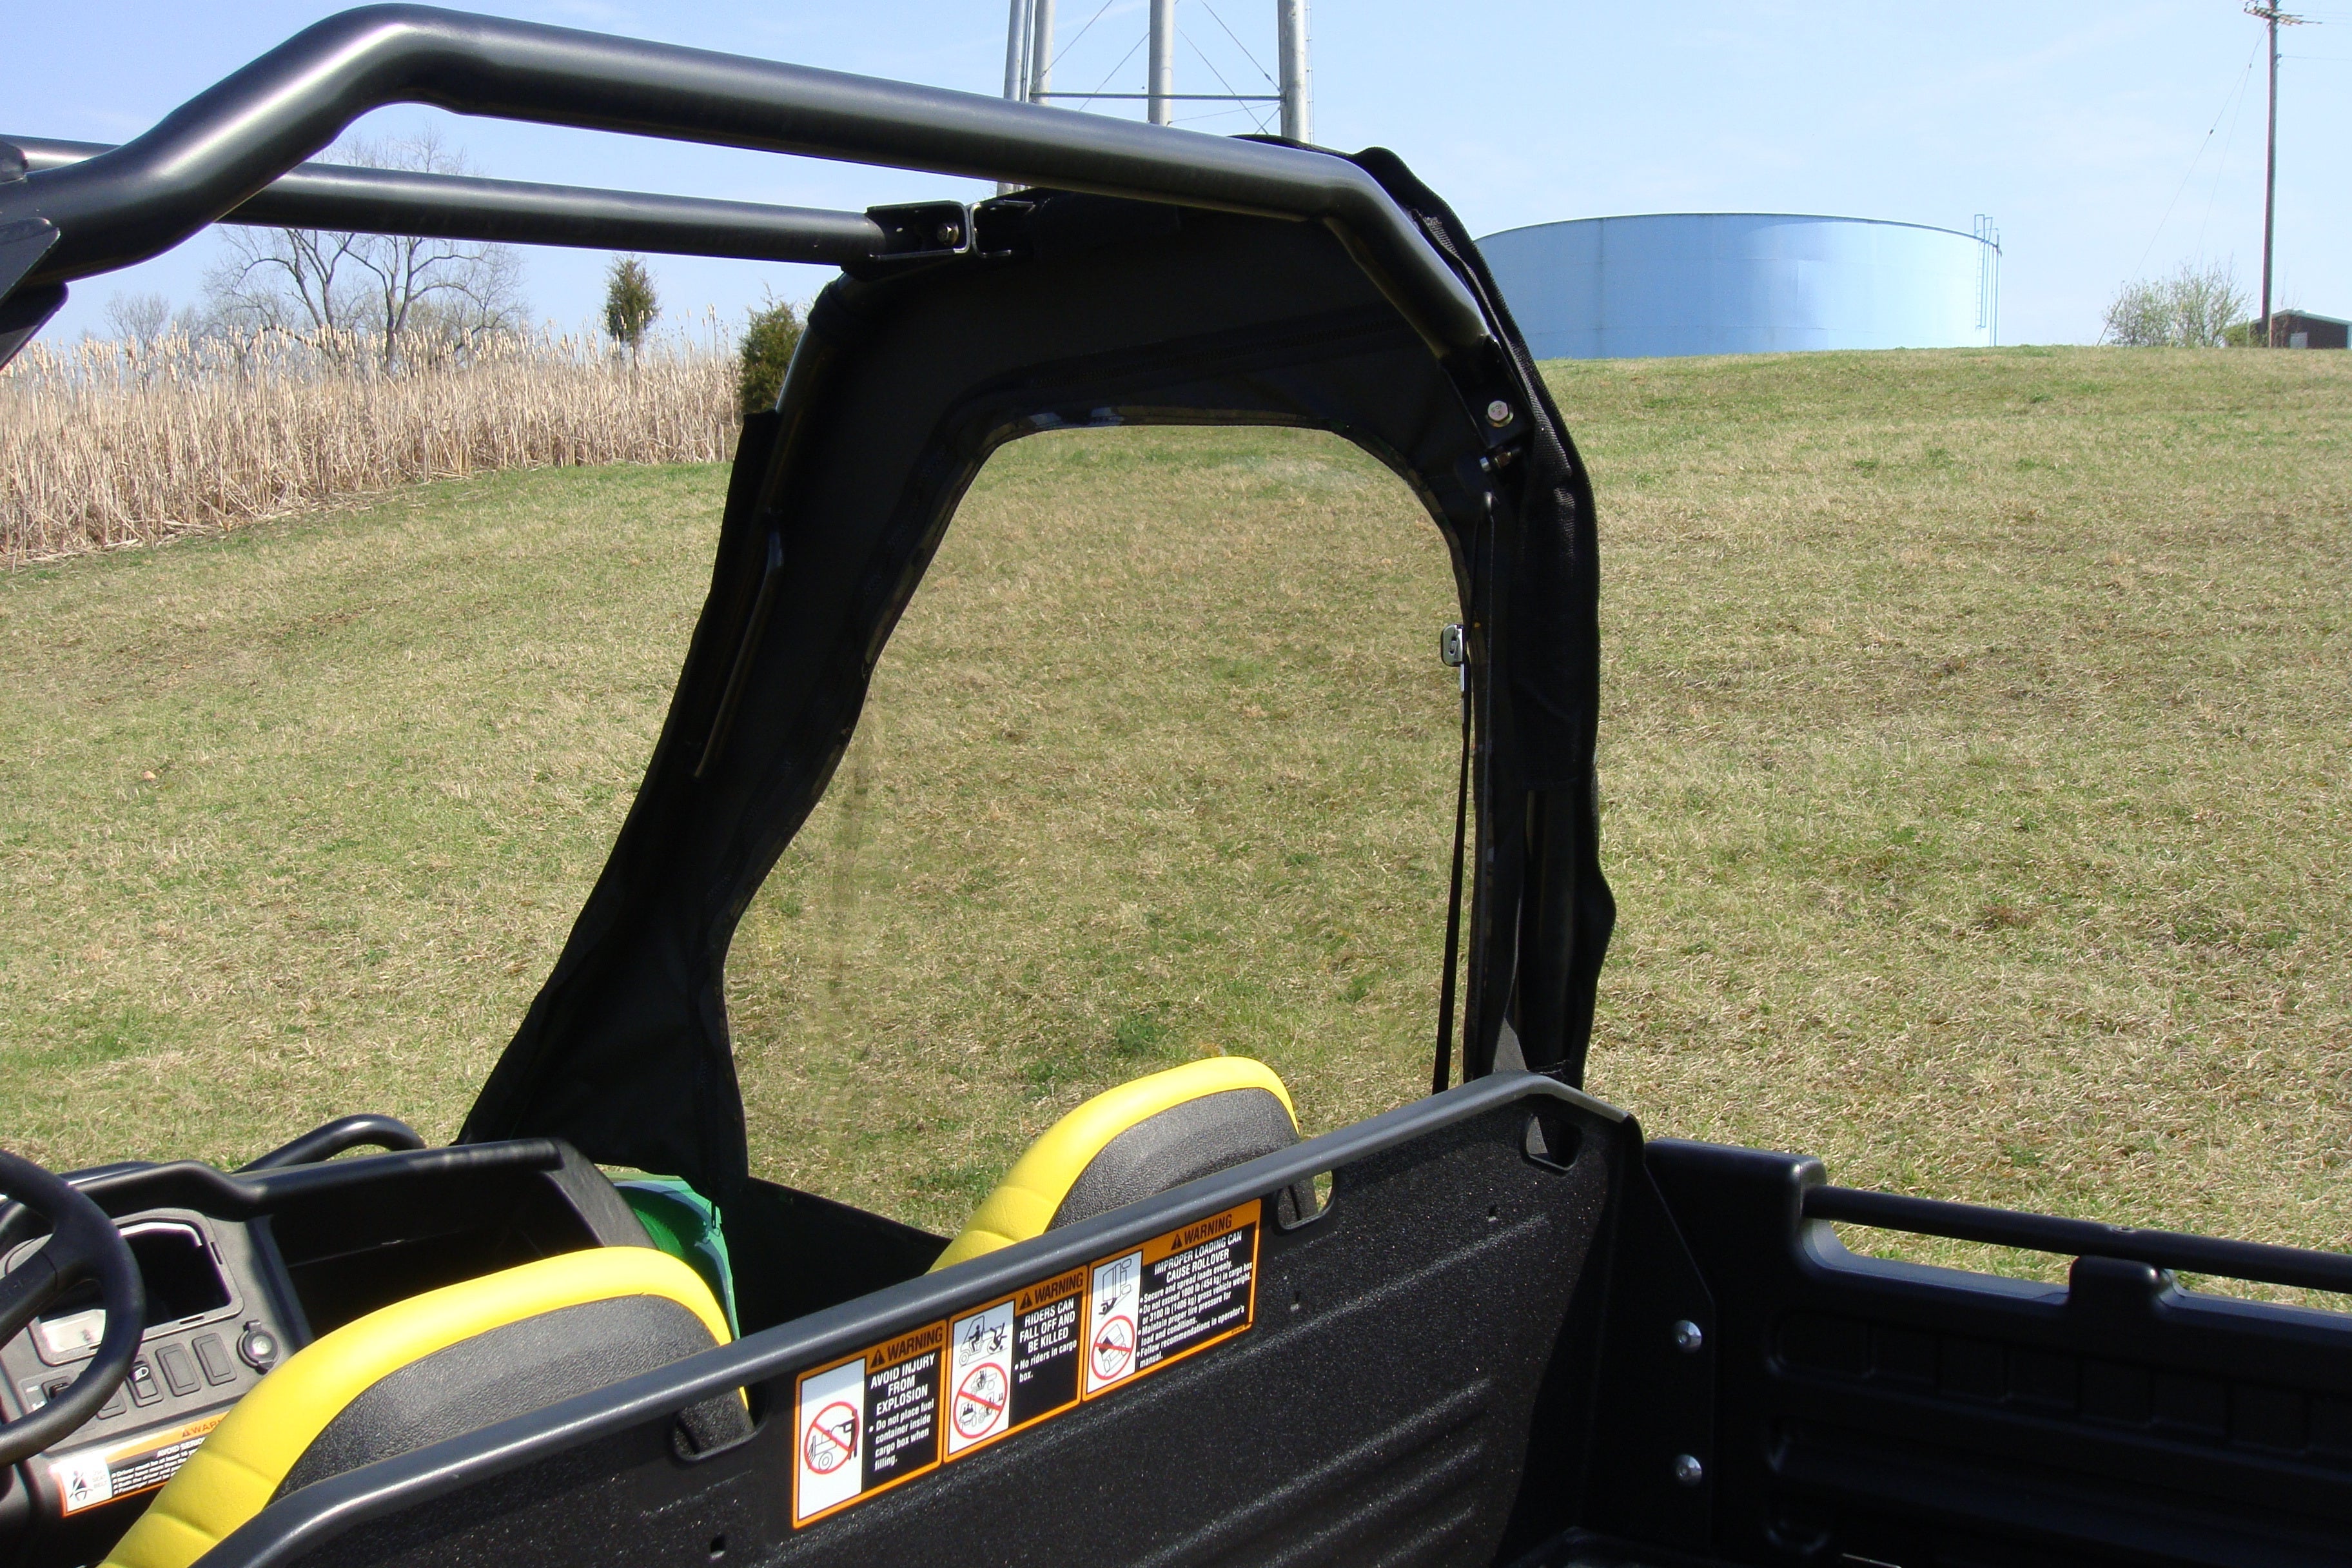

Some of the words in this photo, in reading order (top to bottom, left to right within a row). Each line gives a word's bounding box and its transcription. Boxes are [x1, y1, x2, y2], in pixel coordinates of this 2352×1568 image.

[1184, 1213, 1232, 1245] WARNING
[1154, 1251, 1193, 1275] IMPROPER
[1195, 1237, 1226, 1259] LOADING
[1228, 1230, 1242, 1246] CAN
[1166, 1264, 1191, 1283] CAUSE
[1191, 1248, 1230, 1273] ROLLOVER
[1035, 1272, 1083, 1304] WARNING
[1143, 1304, 1151, 1315] Do
[1152, 1299, 1161, 1311] not
[1162, 1291, 1180, 1306] exceed
[1181, 1285, 1194, 1298] 1000
[1195, 1283, 1200, 1292] lb
[1201, 1277, 1212, 1291] (454
[1213, 1273, 1222, 1286] kg)
[1222, 1272, 1228, 1280] in
[1229, 1266, 1242, 1279] cargo
[1243, 1262, 1253, 1272] box
[1144, 1288, 1164, 1303] Secure
[1165, 1282, 1176, 1295] and
[1177, 1273, 1197, 1290] spread
[1197, 1268, 1212, 1281] loads
[1213, 1260, 1233, 1275] evenly.
[1024, 1305, 1055, 1328] RIDERS
[1057, 1297, 1074, 1315] CAN
[1142, 1317, 1148, 1325] or
[1150, 1308, 1164, 1322] 3100
[1164, 1306, 1170, 1316] lb
[1171, 1298, 1187, 1315] (1406
[1188, 1294, 1197, 1306] kg)
[1198, 1289, 1212, 1304] gross
[1213, 1280, 1232, 1295] vehicle
[1233, 1271, 1251, 1287] weight.
[1019, 1328, 1039, 1344] FALL
[1041, 1318, 1057, 1335] OFF
[1058, 1310, 1075, 1328] AND
[1141, 1342, 1161, 1358] Follow
[1161, 1320, 1210, 1349] recommendations
[1211, 1317, 1217, 1327] in
[1217, 1304, 1245, 1324] operator's
[1142, 1318, 1167, 1336] Maintain
[1168, 1310, 1187, 1326] proper
[1188, 1306, 1198, 1316] tire
[1199, 1295, 1222, 1313] pressure
[888, 1326, 943, 1361] WARNING
[1028, 1340, 1039, 1354] BE
[1041, 1327, 1069, 1349] KILLED
[1141, 1333, 1154, 1347] load
[1155, 1328, 1166, 1340] and
[1167, 1317, 1198, 1335] conditions.
[870, 1367, 899, 1389] AVOID
[902, 1353, 936, 1377] INJURY
[1020, 1359, 1029, 1371] No
[1030, 1350, 1050, 1366] riders
[1051, 1347, 1057, 1358] in
[1059, 1340, 1077, 1355] cargo
[1140, 1350, 1164, 1369] manual.
[888, 1375, 916, 1397] FROM
[1019, 1370, 1034, 1383] box.
[876, 1384, 928, 1416] EXPLOSION
[876, 1420, 887, 1431] Do
[887, 1413, 899, 1427] not
[900, 1406, 919, 1424] place
[921, 1398, 934, 1413] fuel
[191, 1420, 221, 1433] WAR
[876, 1424, 908, 1445] container
[910, 1414, 931, 1431] inside
[876, 1442, 895, 1458] cargo
[896, 1436, 909, 1449] box
[910, 1427, 929, 1443] when
[157, 1446, 180, 1458] AVOID
[181, 1437, 206, 1451] SERIO
[875, 1455, 897, 1471] filling.
